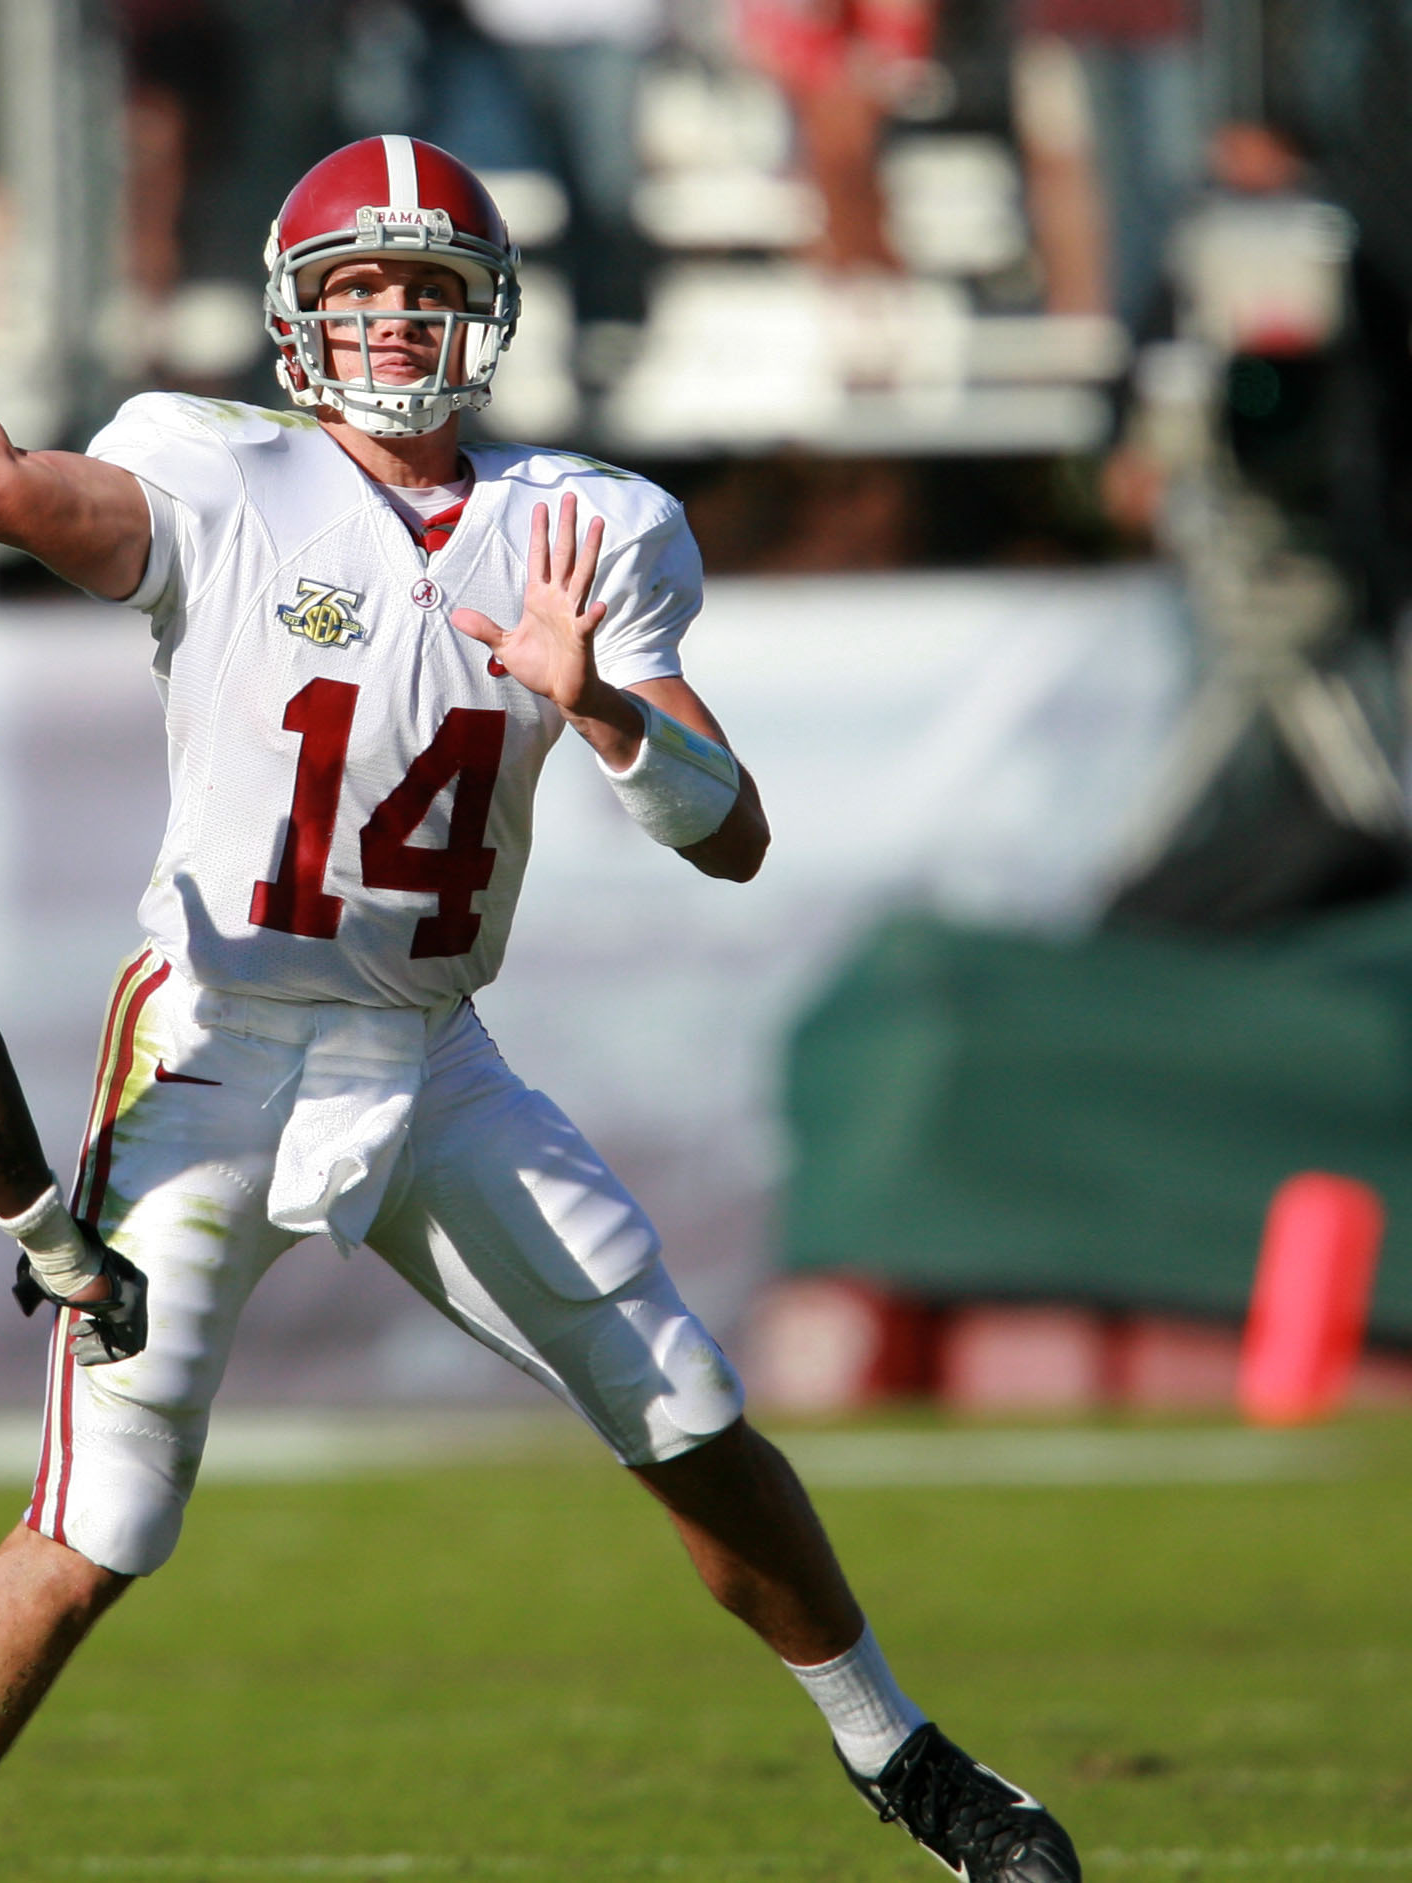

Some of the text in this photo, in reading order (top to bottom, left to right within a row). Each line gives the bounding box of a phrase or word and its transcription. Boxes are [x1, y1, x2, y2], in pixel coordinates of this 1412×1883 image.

[378, 211, 423, 225] BAMA
[303, 605, 341, 643] SEC
[249, 676, 506, 960] 14
